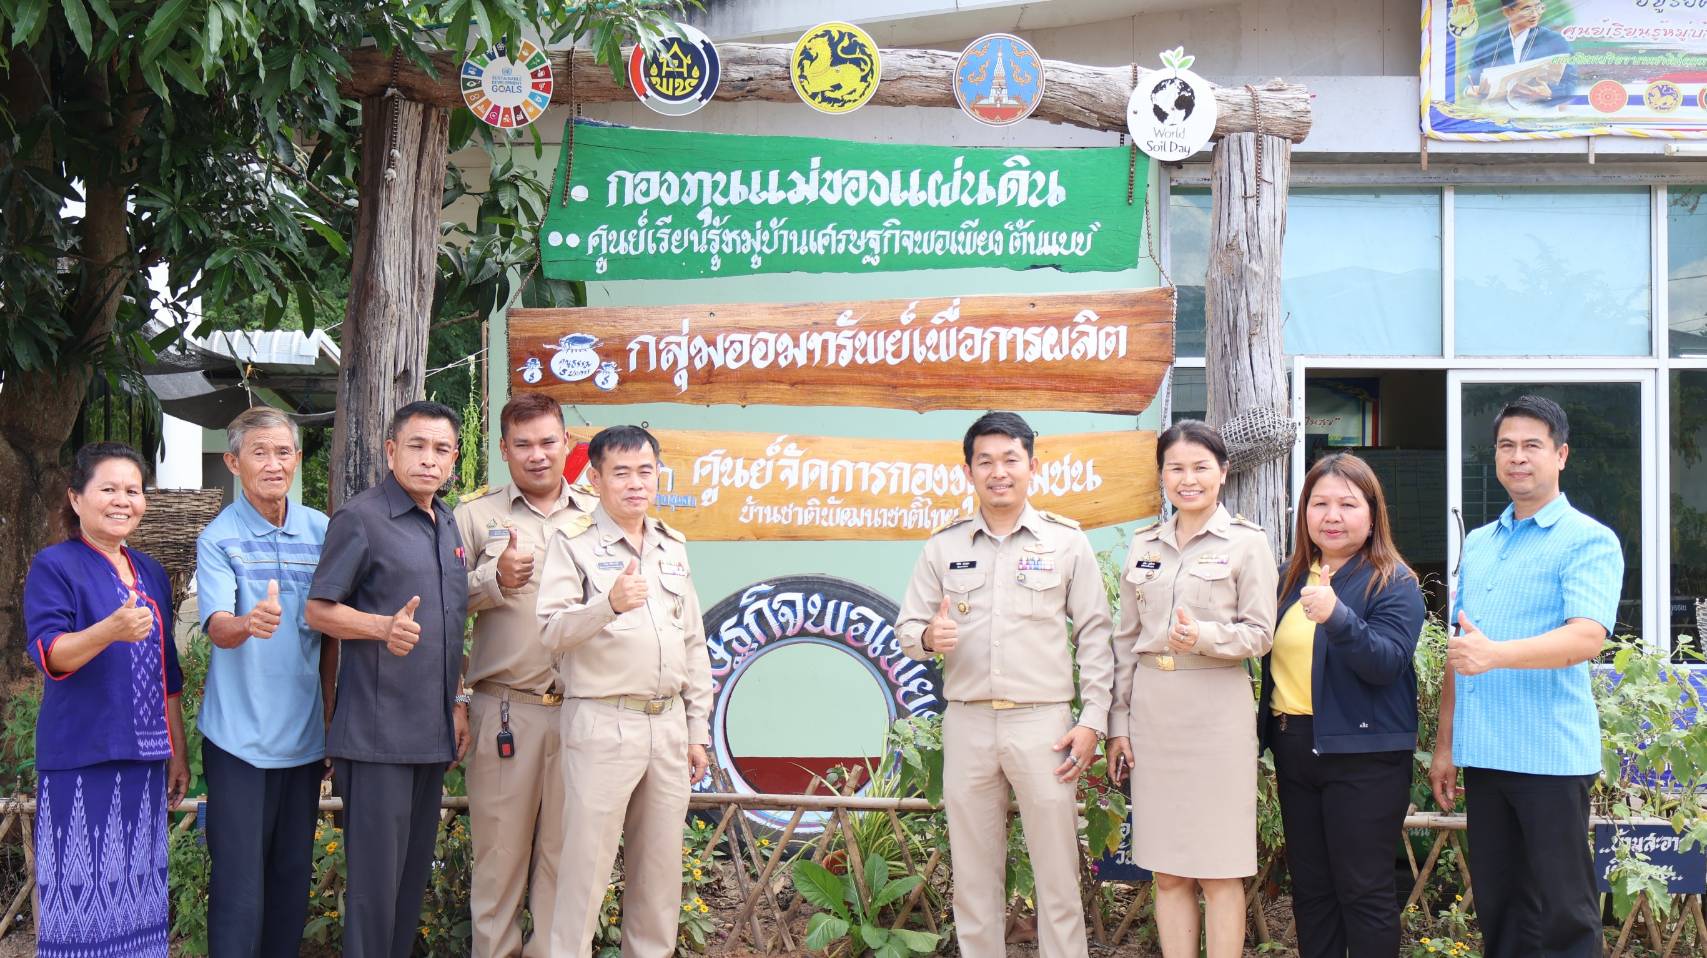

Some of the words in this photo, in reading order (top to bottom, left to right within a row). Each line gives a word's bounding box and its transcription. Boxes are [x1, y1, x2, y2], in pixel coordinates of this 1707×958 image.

[492, 85, 522, 93] GOALS
[1153, 127, 1186, 139] World
[1146, 140, 1167, 153] Soil
[1169, 140, 1191, 156] Day
[606, 154, 1067, 228] กองทุนแม่ของแผ่นดิน
[626, 297, 1128, 395] กลุ่มออมทรัพย์เพื่อการผลิต
